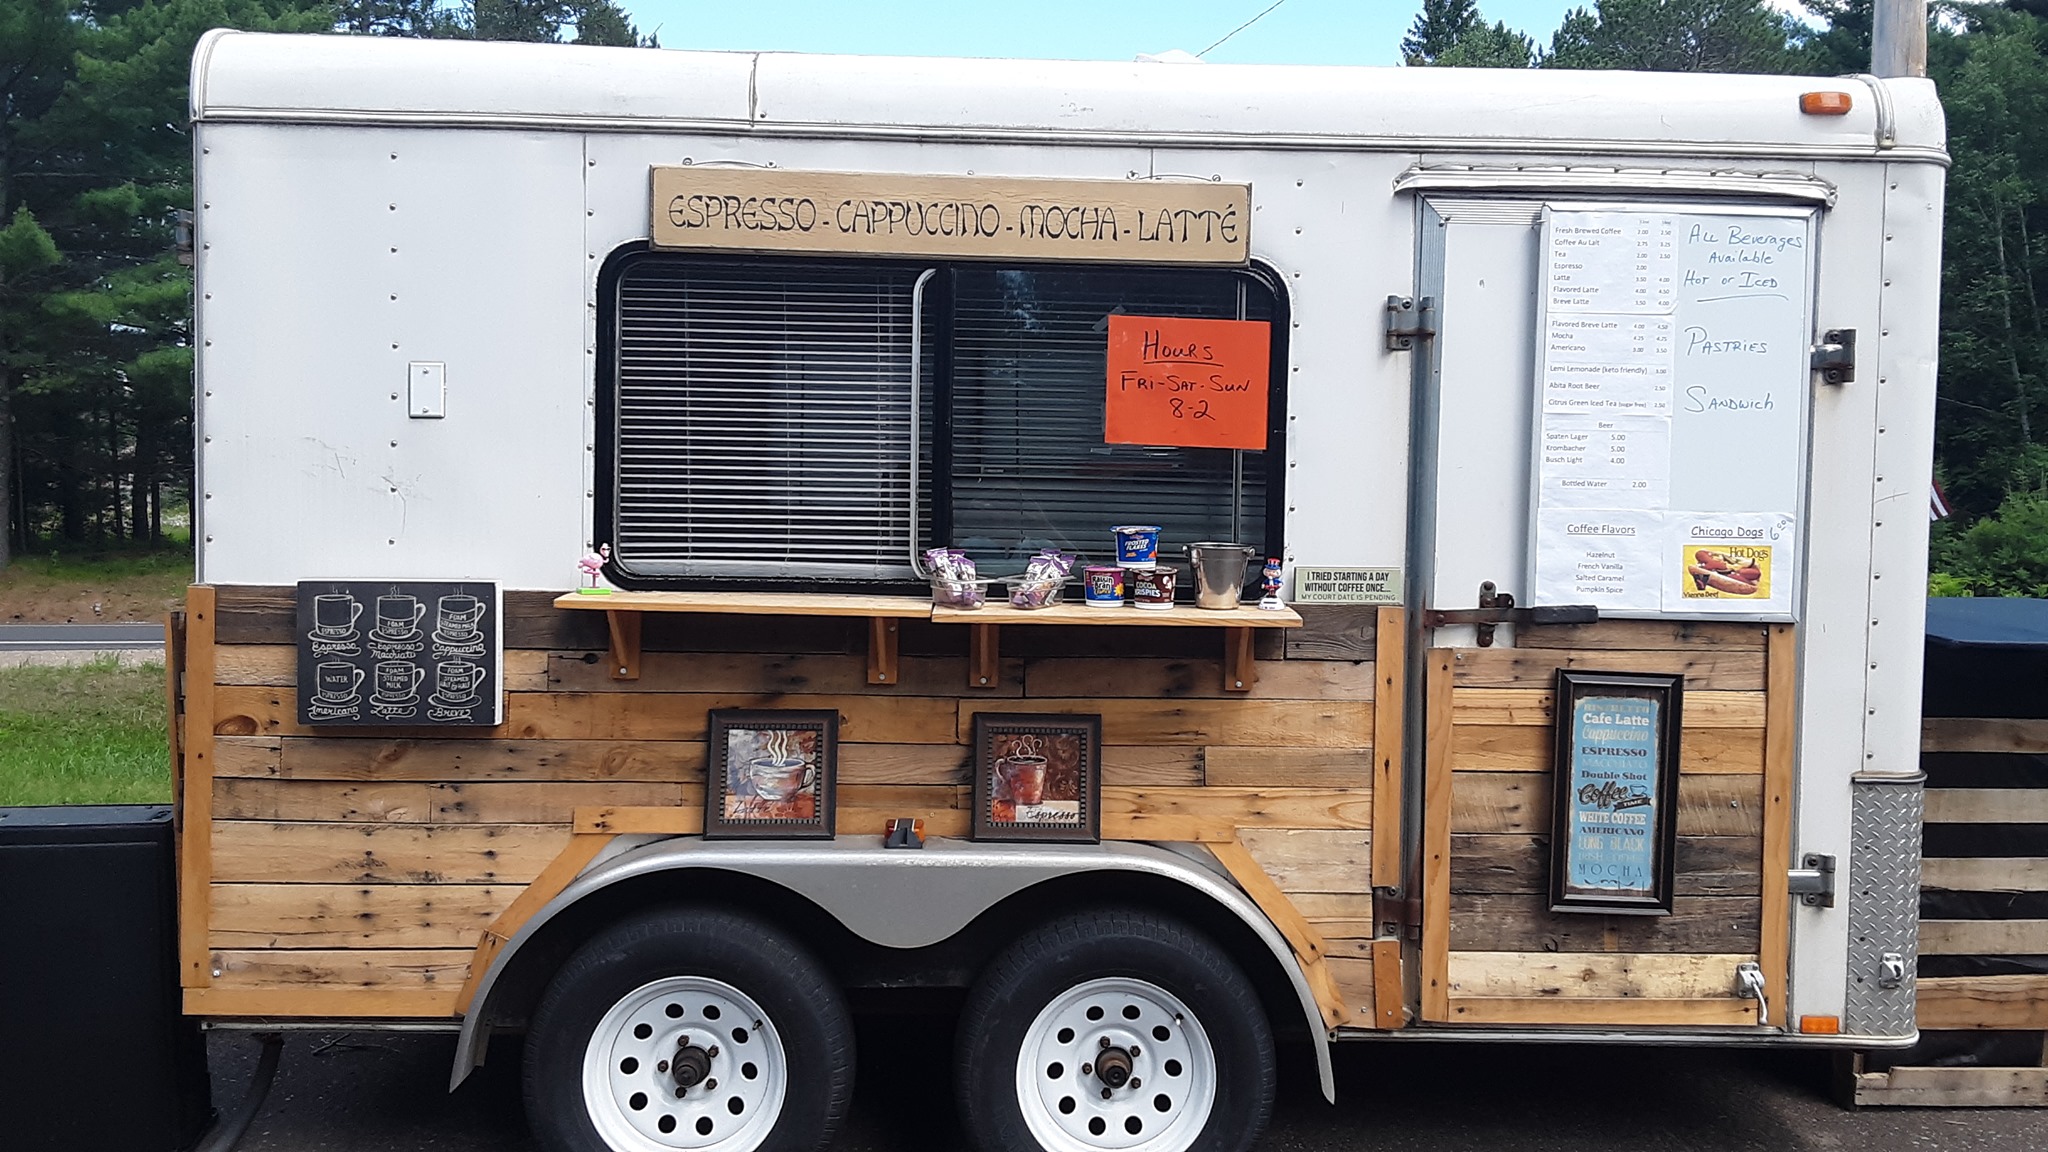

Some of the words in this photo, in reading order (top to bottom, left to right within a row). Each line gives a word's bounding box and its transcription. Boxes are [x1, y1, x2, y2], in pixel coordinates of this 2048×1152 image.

[668, 195, 816, 232] ESPRESSO
[836, 200, 1000, 237] CAPPUCCINO
[1020, 204, 1118, 242] MOCHA
[1138, 204, 1238, 243] LATTÉ
[1728, 225, 1802, 252] Beverages
[1708, 249, 1774, 264] Available
[1554, 263, 1583, 271] Espresso
[1721, 277, 1735, 285] or
[1738, 272, 1778, 288] ICED
[1552, 320, 1580, 328] Flavored
[1550, 344, 1586, 352] Americano
[1602, 366, 1619, 374] (keto
[1620, 367, 1648, 375] friendly)
[1169, 397, 1216, 421] 8-2
[1567, 524, 1599, 533] Coffee
[1601, 524, 1636, 534] Flavors
[1691, 526, 1734, 537] Chicago
[1737, 526, 1764, 539] Dogs
[1729, 547, 1745, 558] Hot
[1746, 548, 1769, 561] Dogs
[1307, 572, 1310, 581] I
[1312, 572, 1332, 581] TRIED
[1333, 572, 1368, 582] STARTING
[1368, 572, 1374, 582] A
[1376, 572, 1390, 582] DAY
[1136, 582, 1156, 590] COCOA
[1304, 582, 1336, 592] WITHOUT
[1338, 583, 1364, 592] COFFEE
[1576, 586, 1605, 594] Pumpkin
[1606, 586, 1624, 594] Spice
[1135, 588, 1161, 598] KRISPIES
[324, 675, 348, 683] WATER
[1582, 712, 1612, 724] Cafe
[1615, 713, 1650, 726] Latte
[1582, 725, 1649, 745] Cappuccino
[1582, 746, 1648, 758] ESPRESSO
[1582, 770, 1620, 780] Double
[1622, 772, 1648, 780] Shot
[1578, 781, 1630, 810] Coffee
[1026, 807, 1079, 822] Espresso
[1579, 810, 1610, 824] WHITE
[1611, 812, 1647, 825] COFFEE
[1580, 826, 1645, 836] AMERICANO
[1578, 836, 1604, 850] LONG
[1610, 838, 1644, 852] BLACK
[1578, 864, 1642, 878] MOCHA
